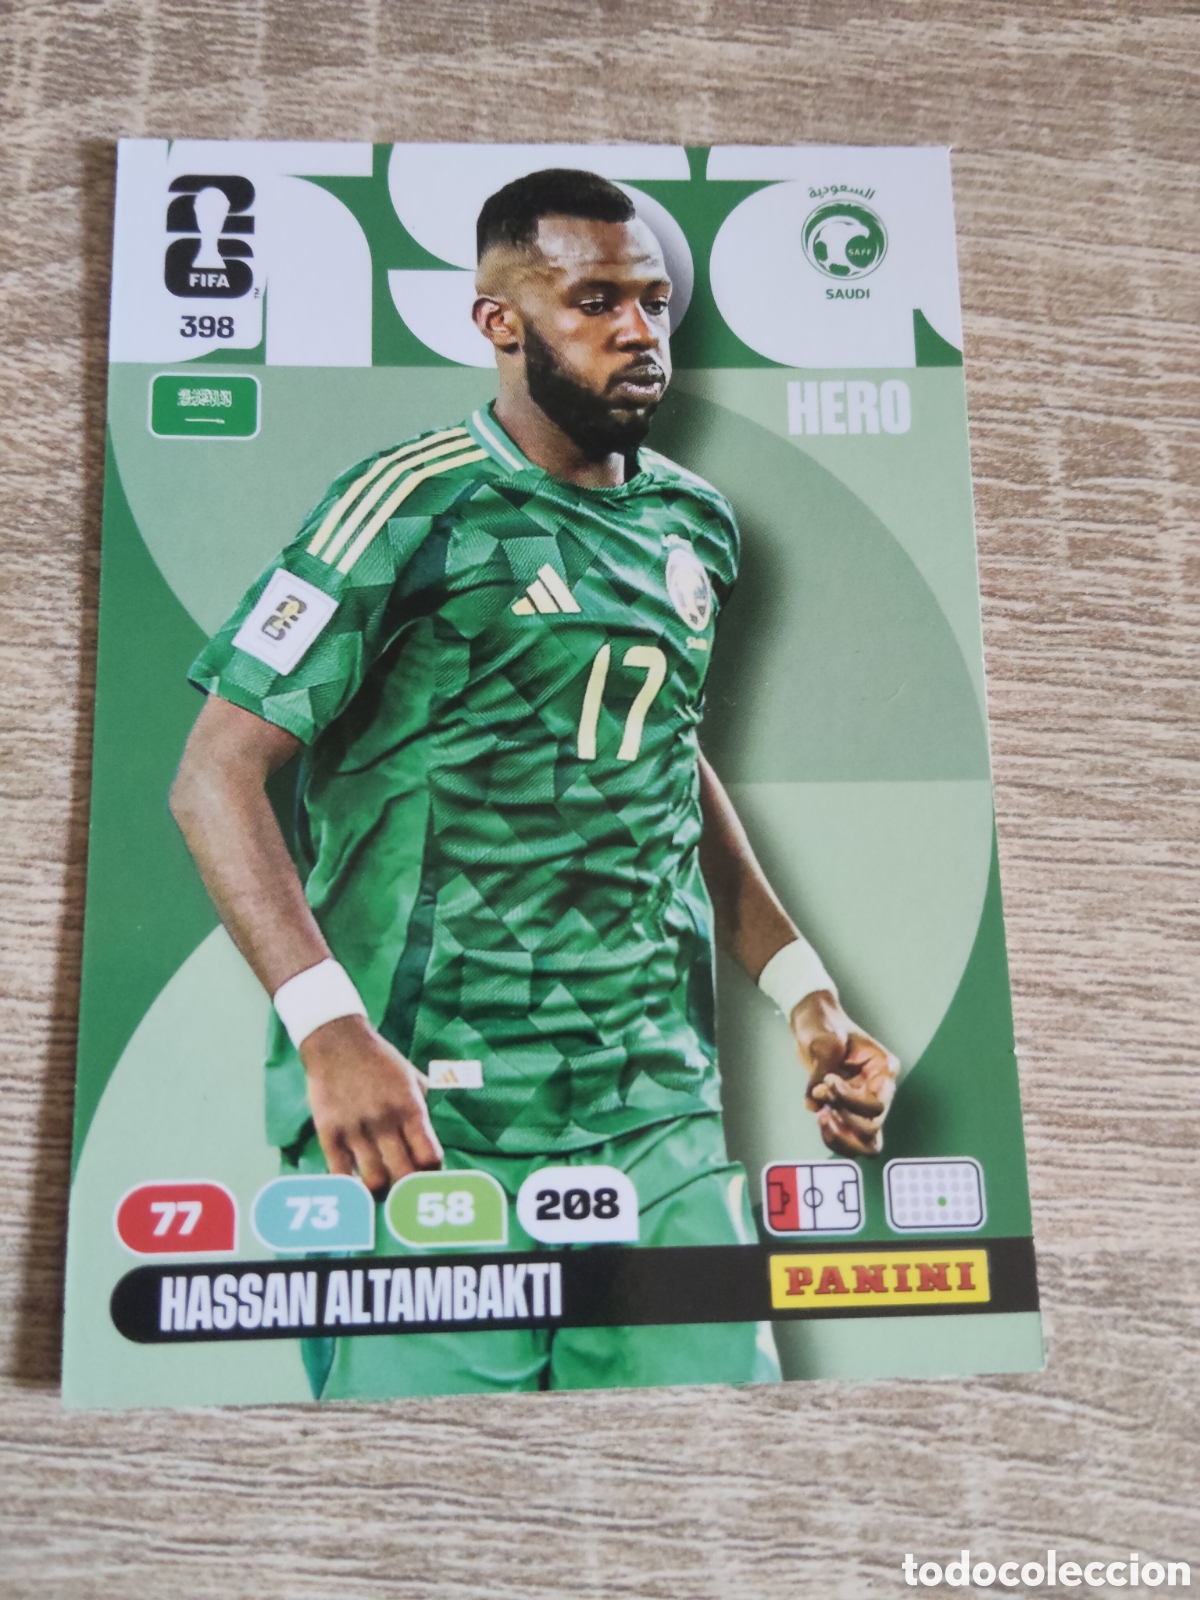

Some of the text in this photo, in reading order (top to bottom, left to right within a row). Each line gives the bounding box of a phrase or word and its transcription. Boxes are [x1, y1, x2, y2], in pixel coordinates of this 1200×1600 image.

[809, 184, 876, 200] السعودية
[848, 248, 872, 257] SAFF
[189, 273, 231, 288] FIFA
[825, 288, 871, 300] SAUDI
[180, 315, 235, 339] 398
[786, 380, 912, 435] HERO
[577, 643, 667, 761] 17
[151, 1201, 203, 1236] 77
[286, 1195, 340, 1230] 73
[416, 1191, 476, 1226] 58
[535, 1188, 621, 1221] 208
[784, 1262, 977, 1296] PANINI
[159, 1262, 563, 1333] HASSAN ALTAMBAKTI
